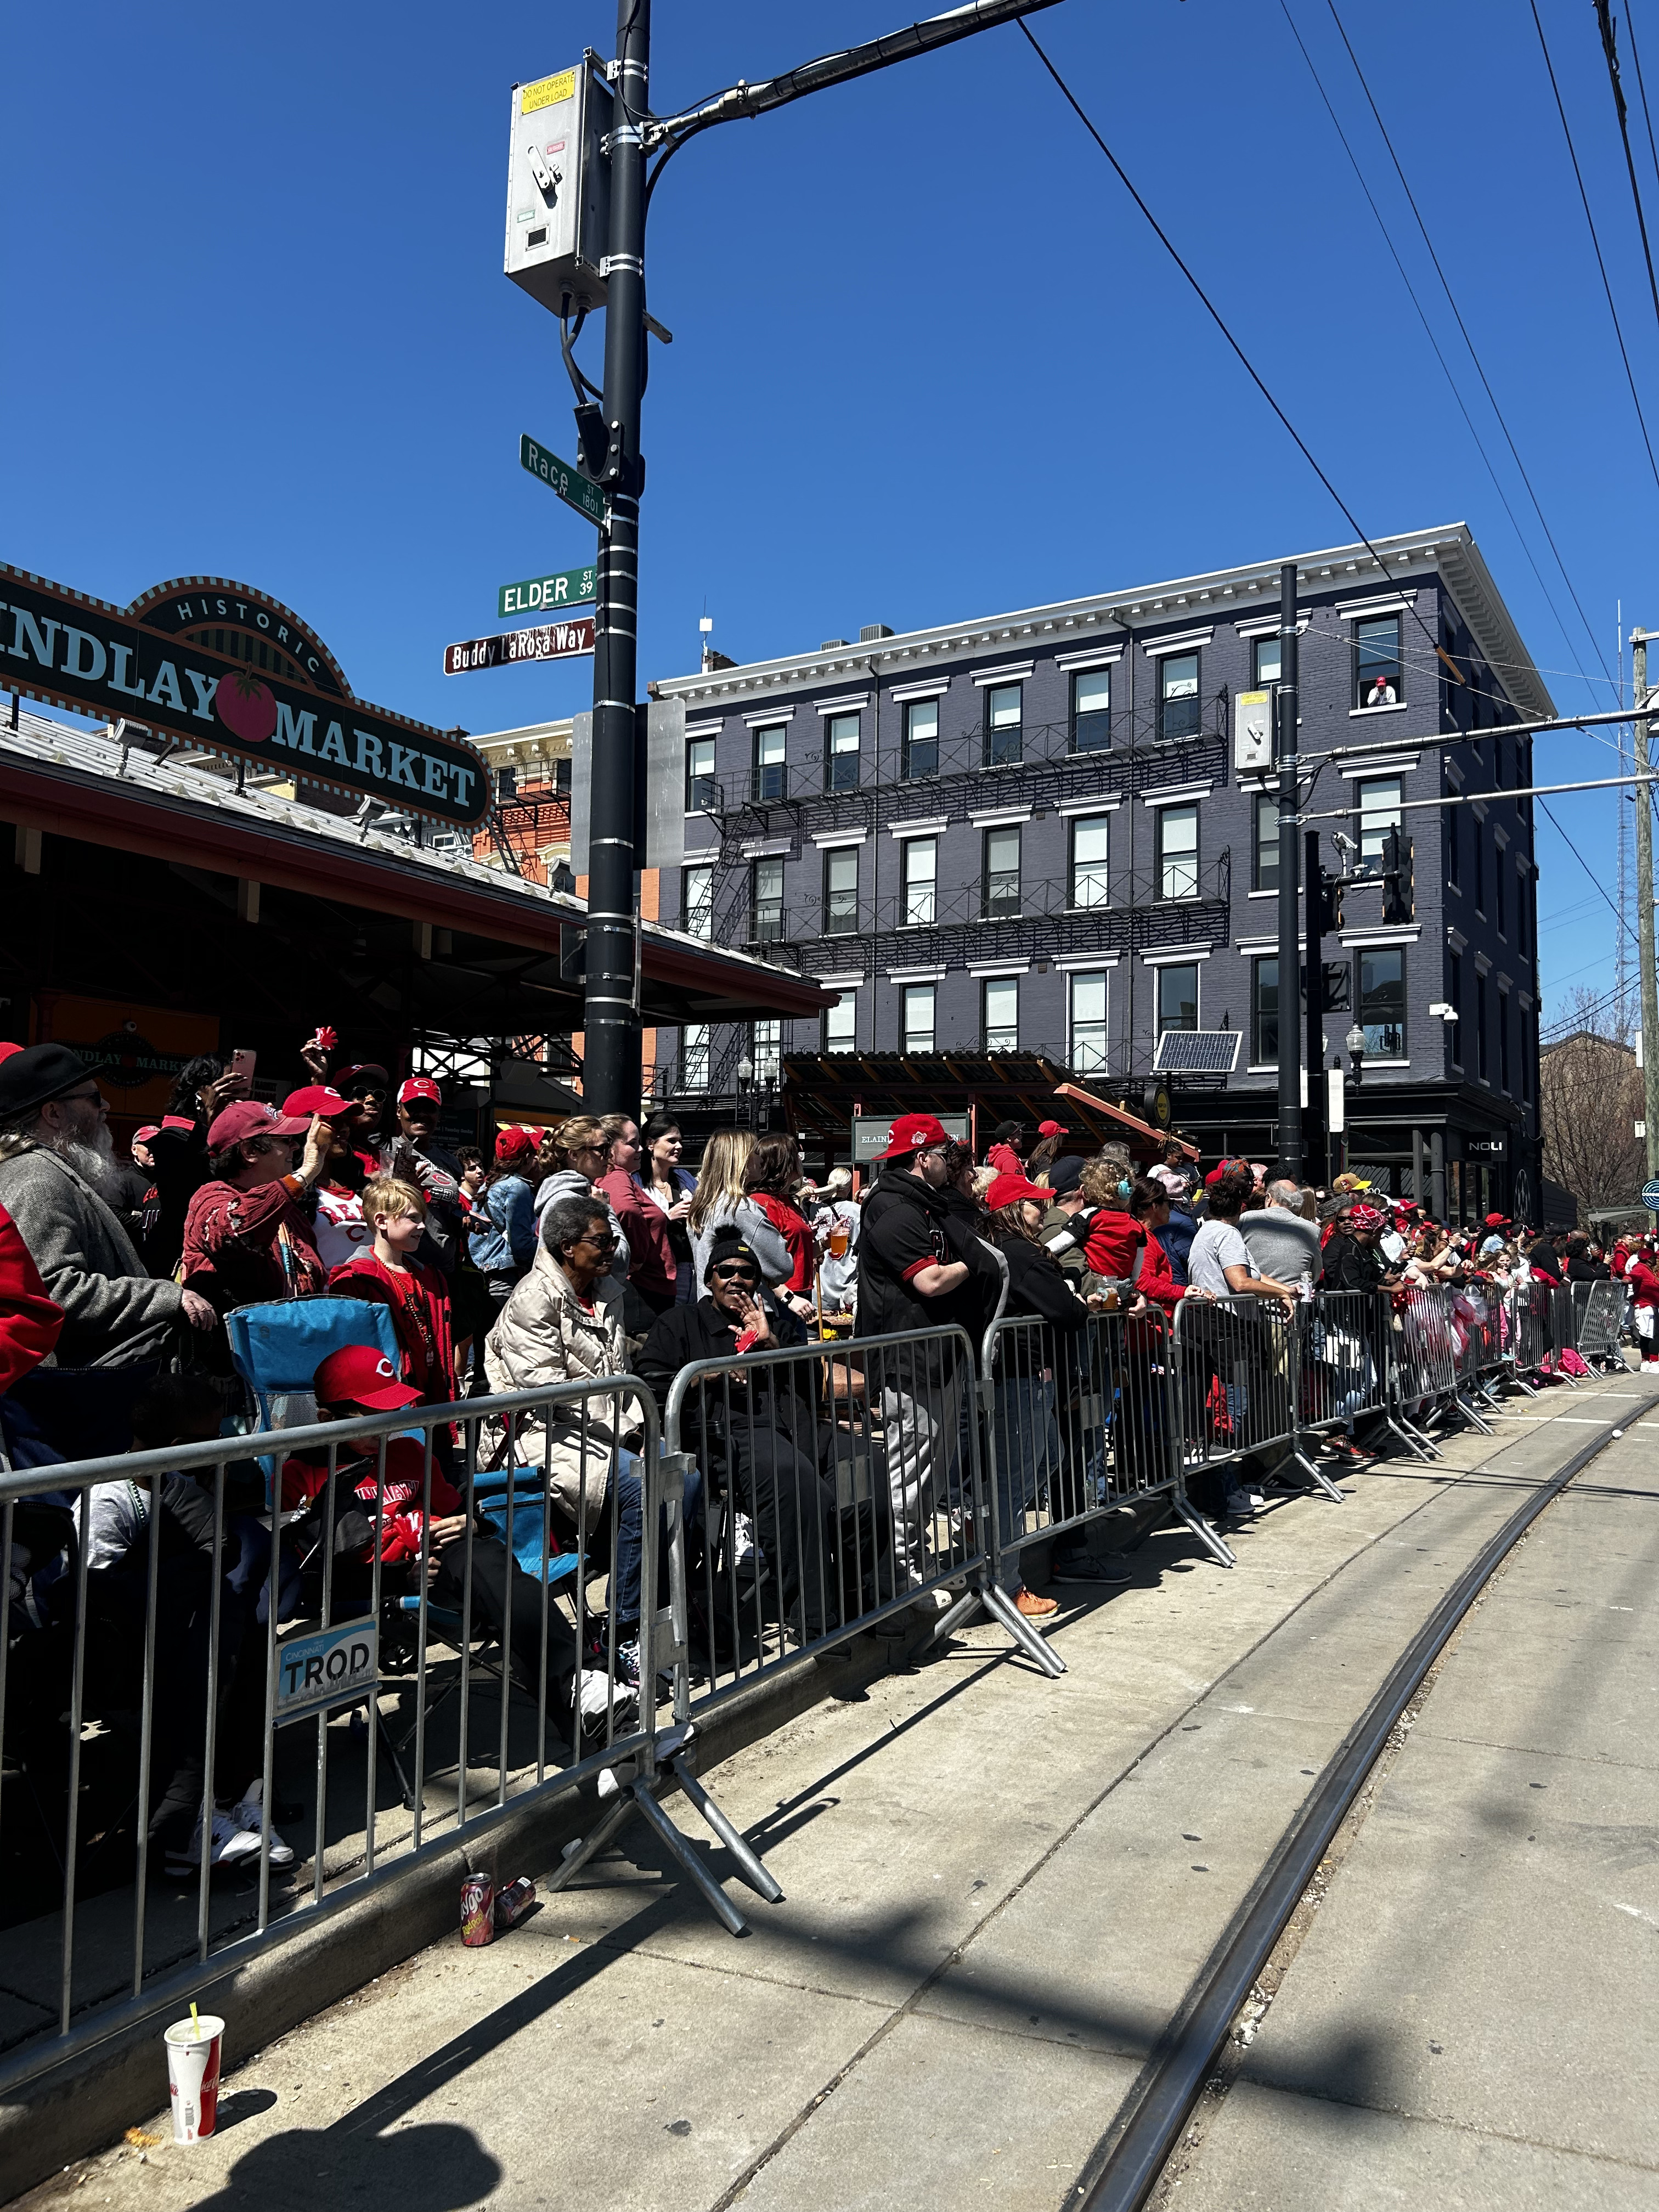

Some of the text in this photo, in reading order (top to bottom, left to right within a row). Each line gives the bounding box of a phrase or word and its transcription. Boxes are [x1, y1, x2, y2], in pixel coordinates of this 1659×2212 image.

[523, 74, 574, 99] DO NOT OPERATE
[529, 89, 567, 109] UNDER LOAD
[528, 442, 568, 492] Race
[586, 483, 594, 495] ST
[582, 493, 599, 515] 1801
[583, 569, 593, 580] ST
[504, 577, 568, 612] ELDER
[579, 582, 593, 596] 39
[177, 598, 319, 673] HISTORIC
[453, 625, 586, 669] Buddy LaRosa Way
[0, 602, 476, 808] NDLAY MARKET
[1469, 1142, 1502, 1150] NOLI
[345, 1224, 367, 1243] C
[375, 1357, 394, 1377] C
[285, 1644, 325, 1662] CINCINNATI
[285, 1643, 370, 1694] TROD
[460, 1887, 484, 1921] aygo
